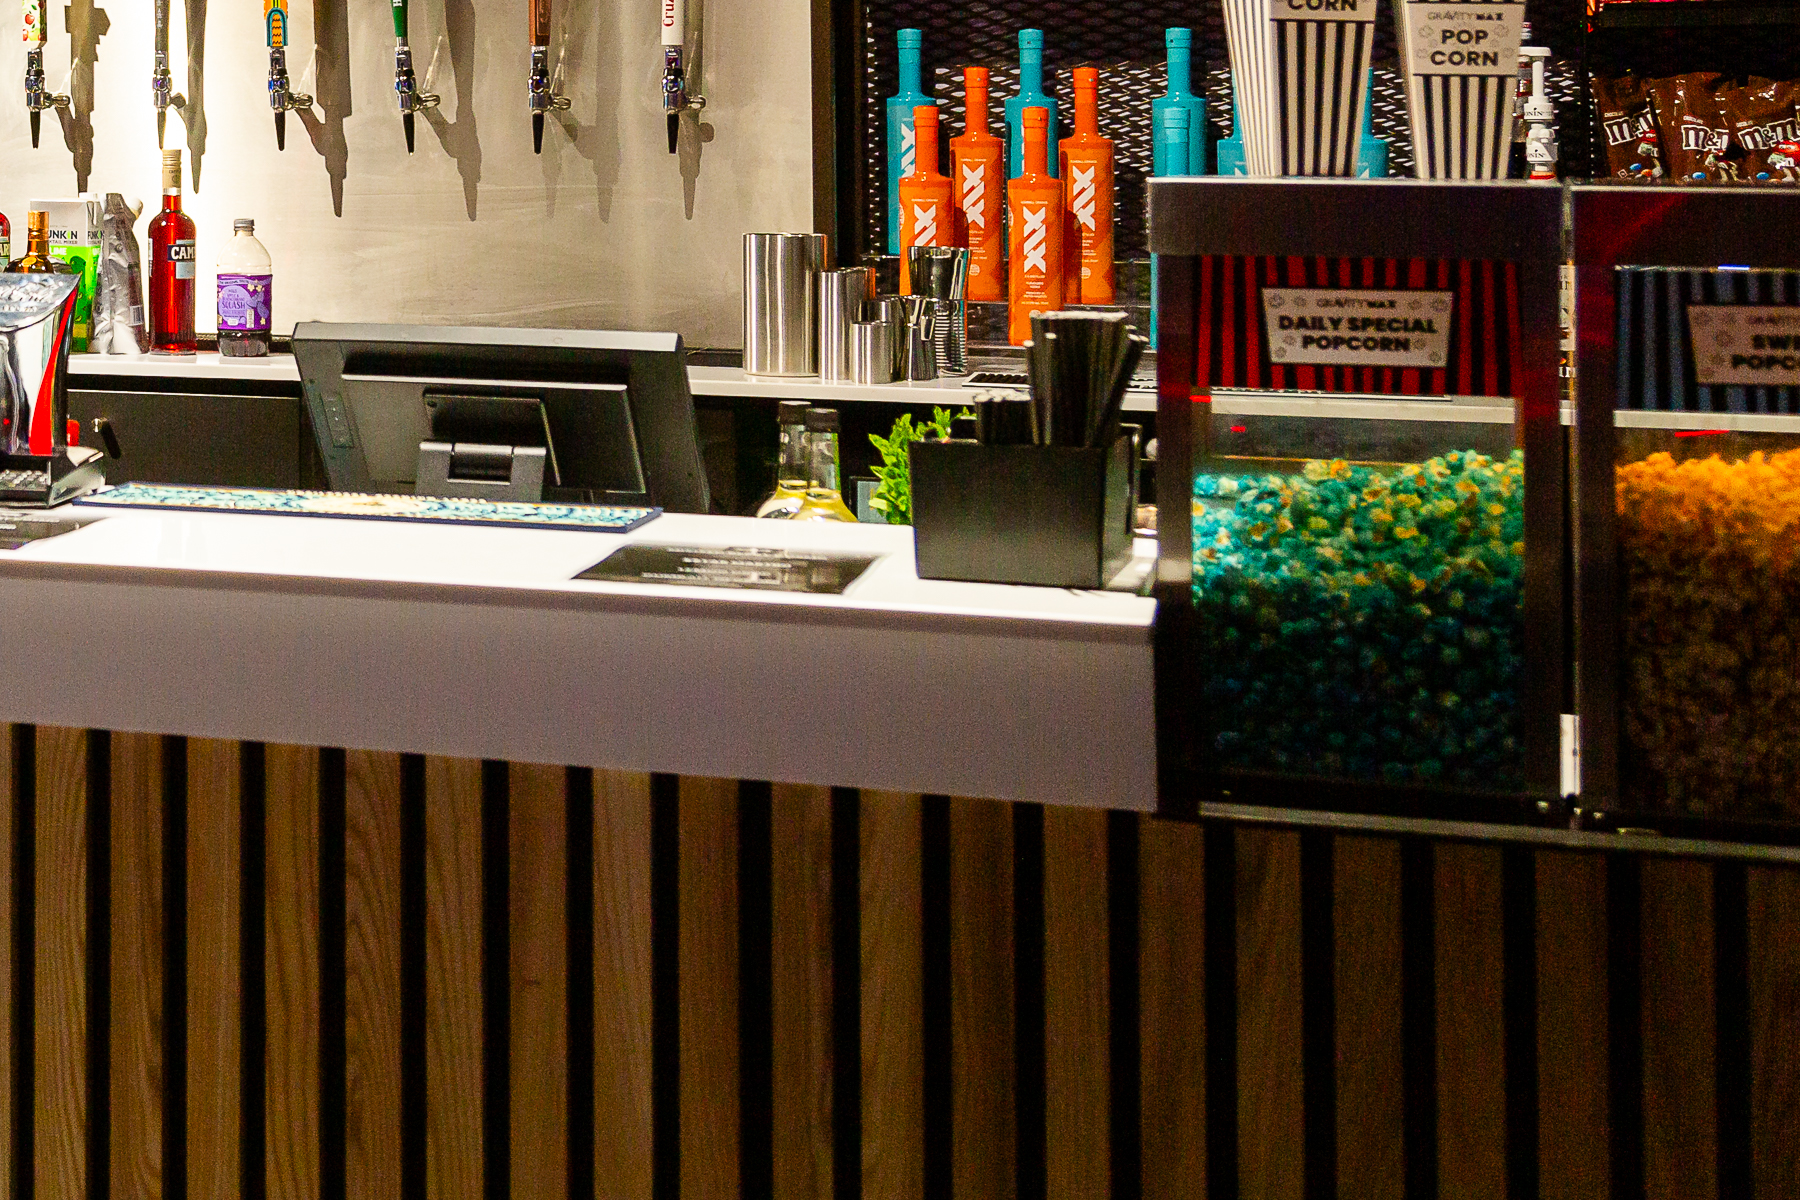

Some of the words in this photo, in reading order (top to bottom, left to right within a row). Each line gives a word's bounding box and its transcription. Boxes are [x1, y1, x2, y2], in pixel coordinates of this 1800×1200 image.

[1441, 29, 1489, 45] POP
[1430, 51, 1498, 66] CORN
[1278, 315, 1342, 331] DAILY
[1347, 317, 1439, 334] SPECIAL
[1302, 335, 1411, 352] POPCORN
